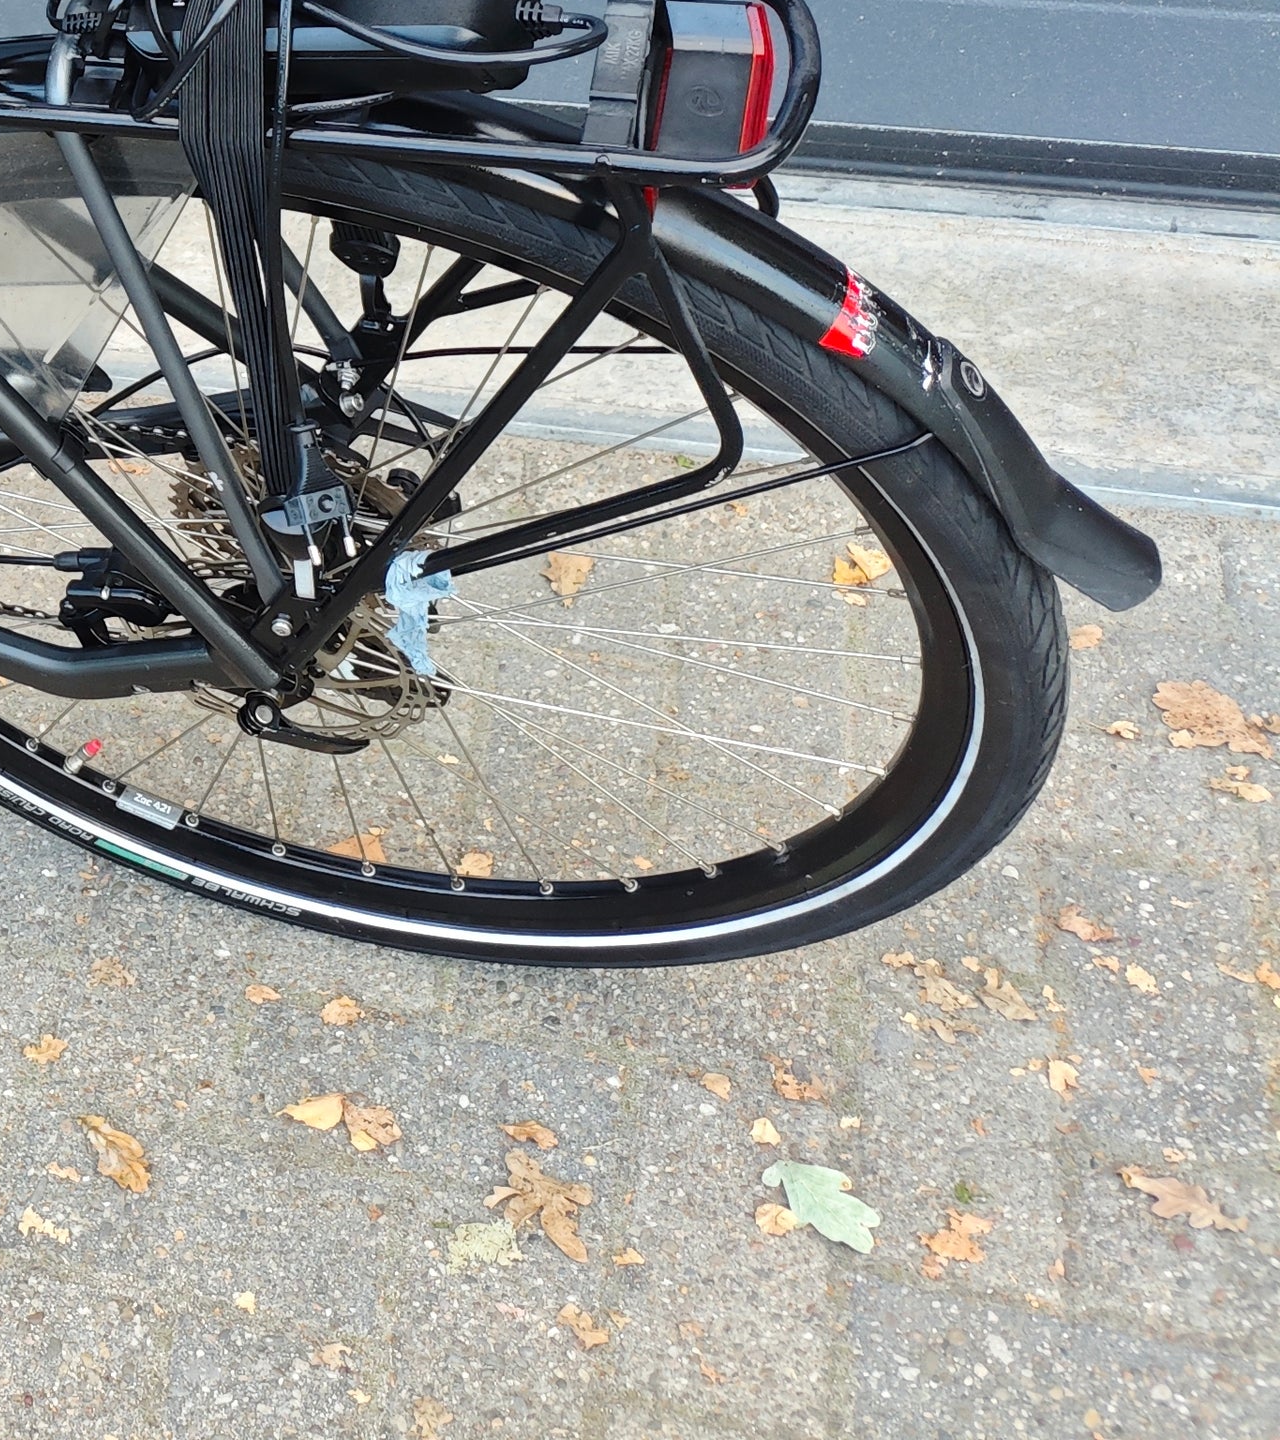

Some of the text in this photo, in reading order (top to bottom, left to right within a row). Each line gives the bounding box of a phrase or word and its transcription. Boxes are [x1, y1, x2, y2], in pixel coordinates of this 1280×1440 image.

[603, 43, 621, 65] MIK
[133, 792, 153, 807] Zac
[153, 801, 172, 815] 421
[48, 816, 95, 841] ROAD
[191, 877, 302, 917] SCHWALBE
